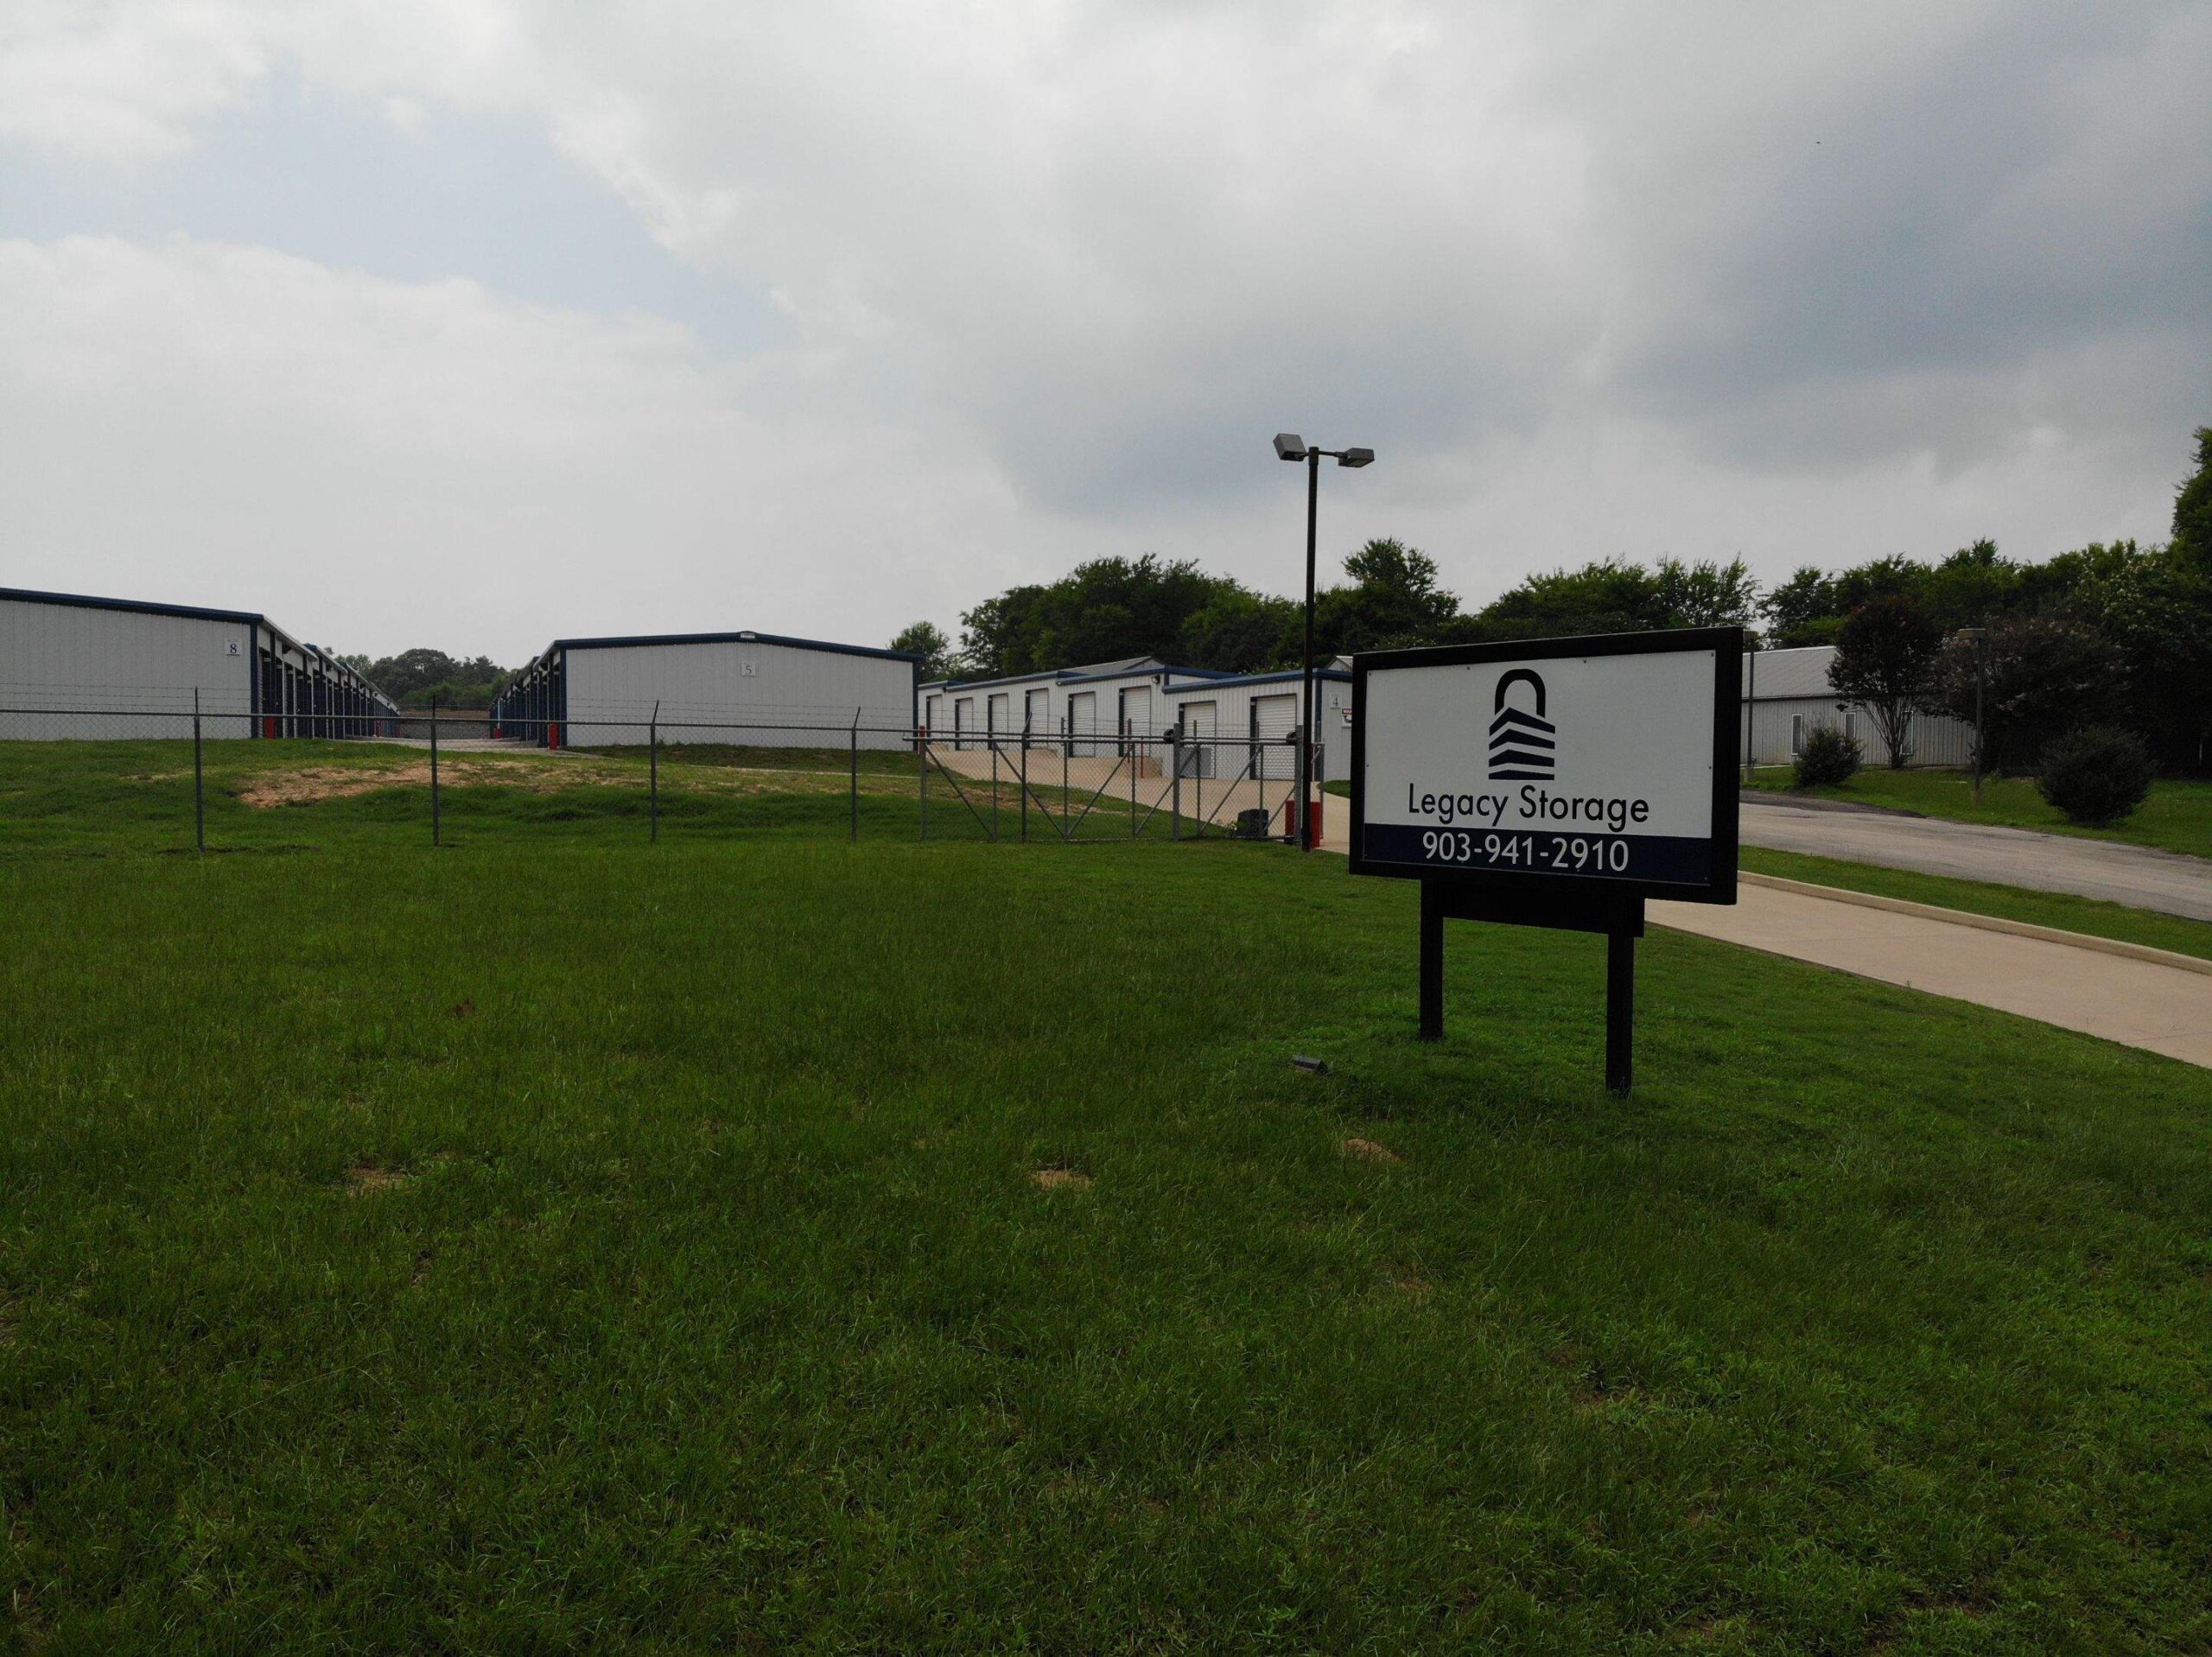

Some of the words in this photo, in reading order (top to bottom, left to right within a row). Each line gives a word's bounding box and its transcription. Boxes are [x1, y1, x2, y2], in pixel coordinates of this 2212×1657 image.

[230, 643, 237, 654] 8
[746, 665, 752, 676] 5
[1332, 697, 1339, 707] 4
[1408, 783, 1510, 828] Legacy
[1518, 784, 1649, 833] Storage
[1422, 831, 1629, 872] 903-941-2910
